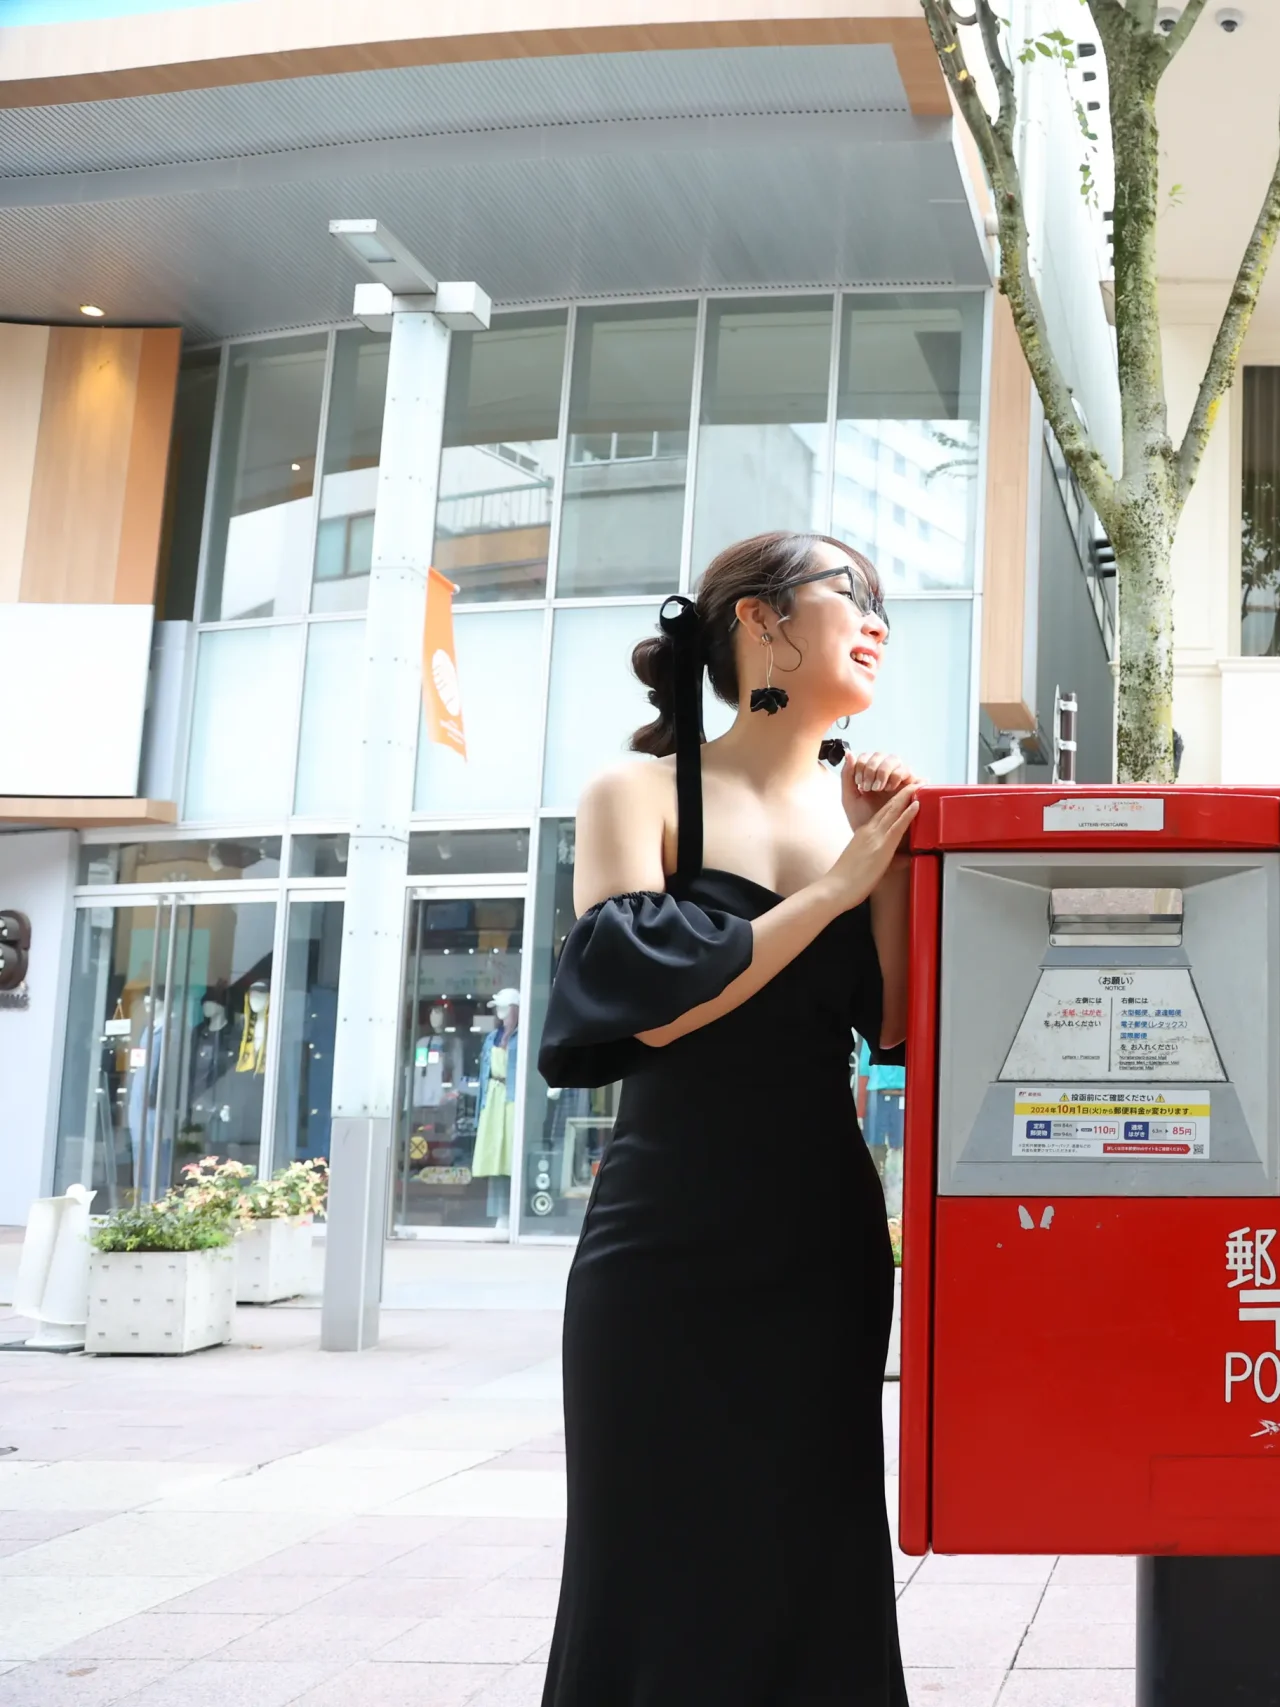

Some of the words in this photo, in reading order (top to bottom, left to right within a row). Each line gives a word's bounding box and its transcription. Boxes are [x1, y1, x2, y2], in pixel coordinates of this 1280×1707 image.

[1071, 1093, 1155, 1102] 投函前にご確認ください
[1093, 1126, 1116, 1135] 110円
[1172, 1126, 1192, 1135] 85円
